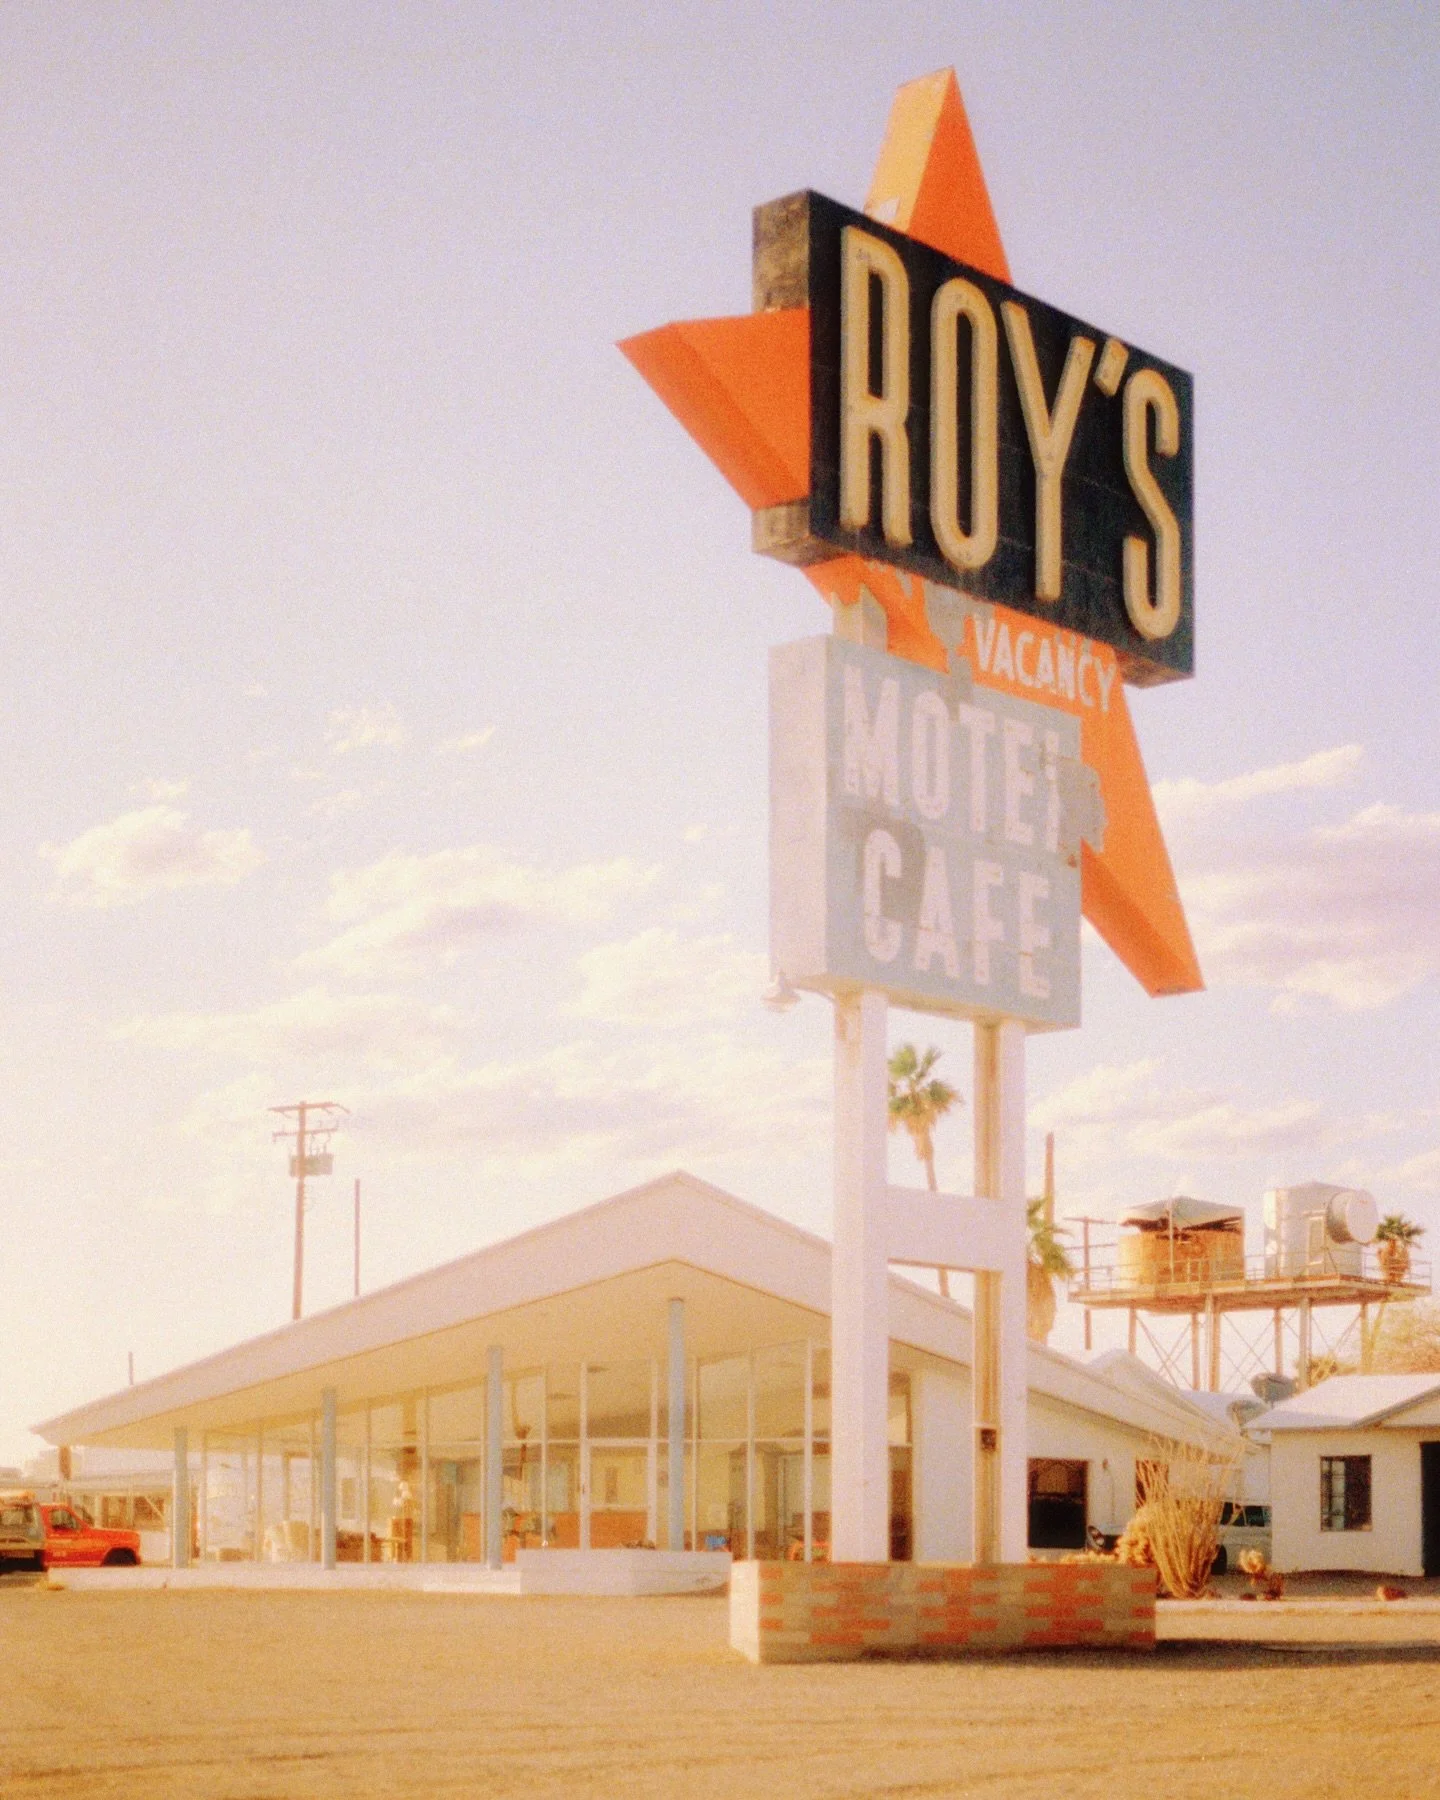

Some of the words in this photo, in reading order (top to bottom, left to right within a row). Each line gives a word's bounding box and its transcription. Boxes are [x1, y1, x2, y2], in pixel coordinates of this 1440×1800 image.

[840, 225, 1181, 641] ROY'S
[974, 612, 1117, 712] VACANCY
[863, 829, 1053, 999] CAFE
